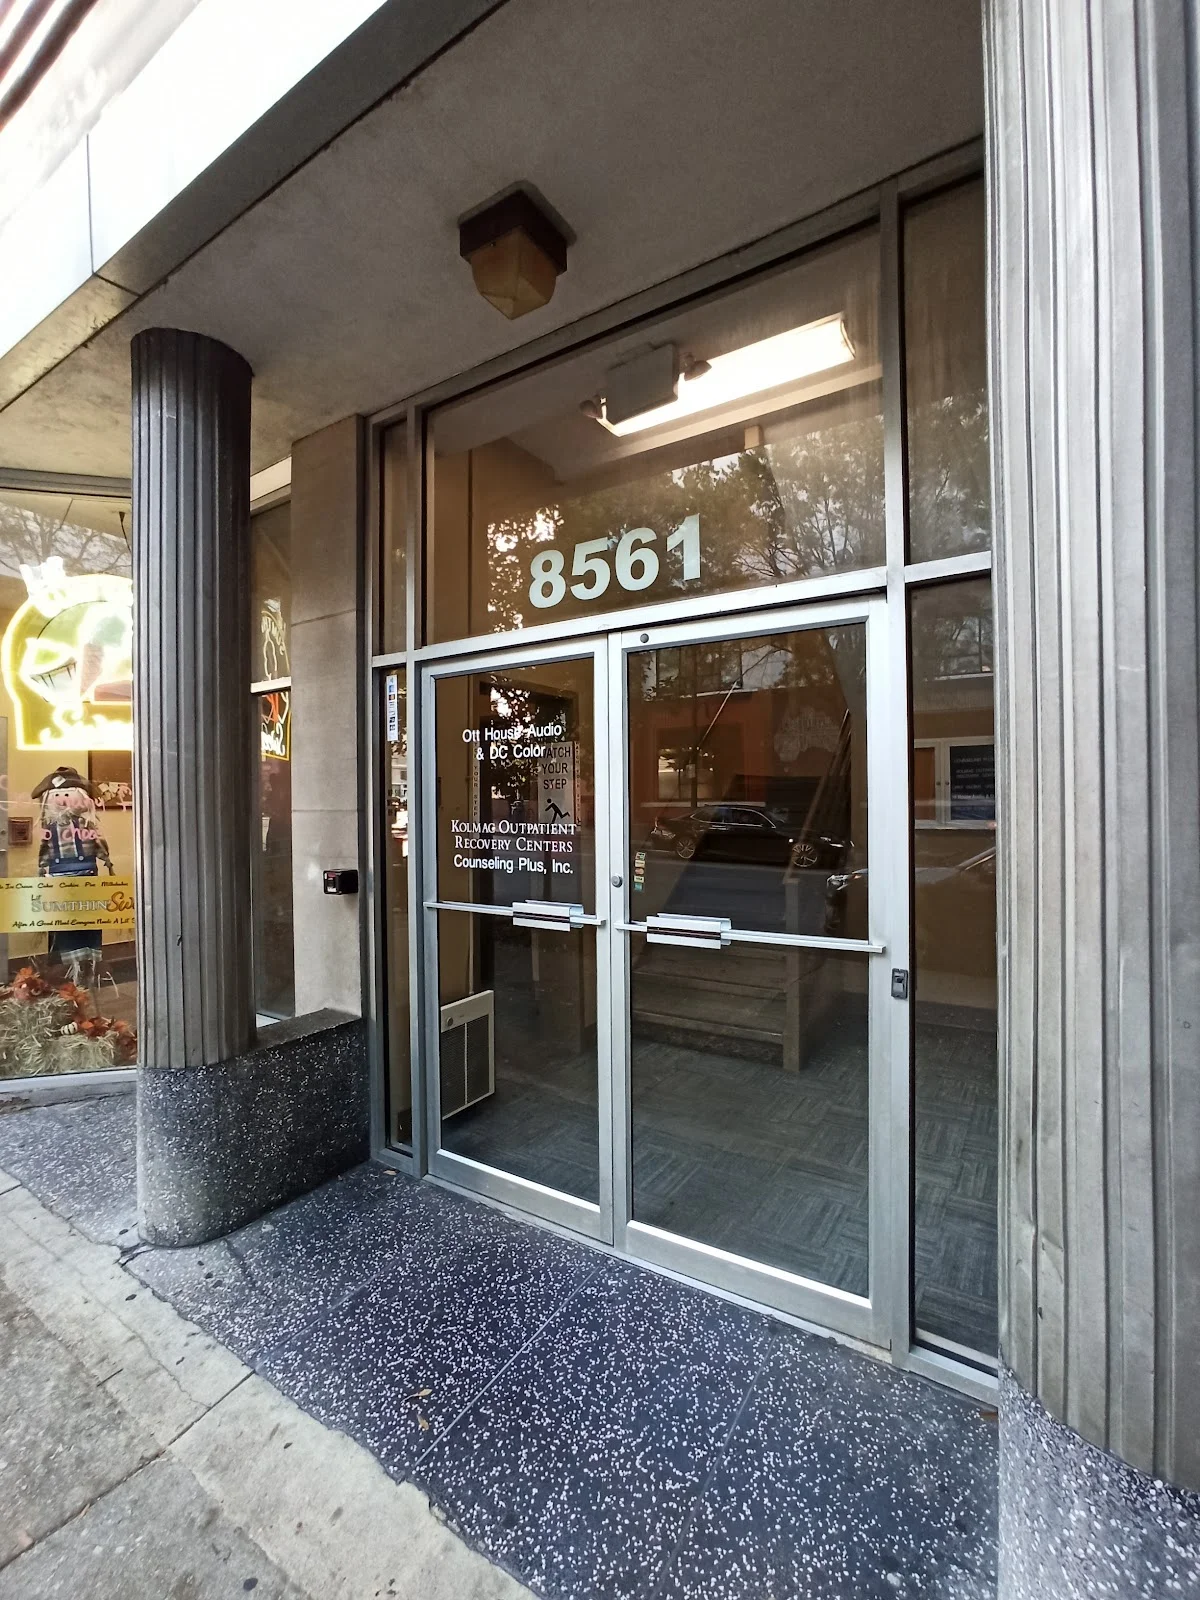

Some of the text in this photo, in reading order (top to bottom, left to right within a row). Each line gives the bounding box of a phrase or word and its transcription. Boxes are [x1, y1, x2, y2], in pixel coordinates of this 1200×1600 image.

[529, 513, 700, 608] 8561
[462, 723, 562, 742] Ott House Audio
[476, 747, 484, 760] &
[489, 744, 508, 759] DC
[513, 743, 545, 758] Color
[541, 763, 568, 775] YOUR
[543, 779, 567, 790] STEP
[498, 819, 577, 835] OUTPATIENT
[455, 835, 573, 852] RECOVERY CENTERS
[454, 854, 573, 875] Counseling Plus, Inc.
